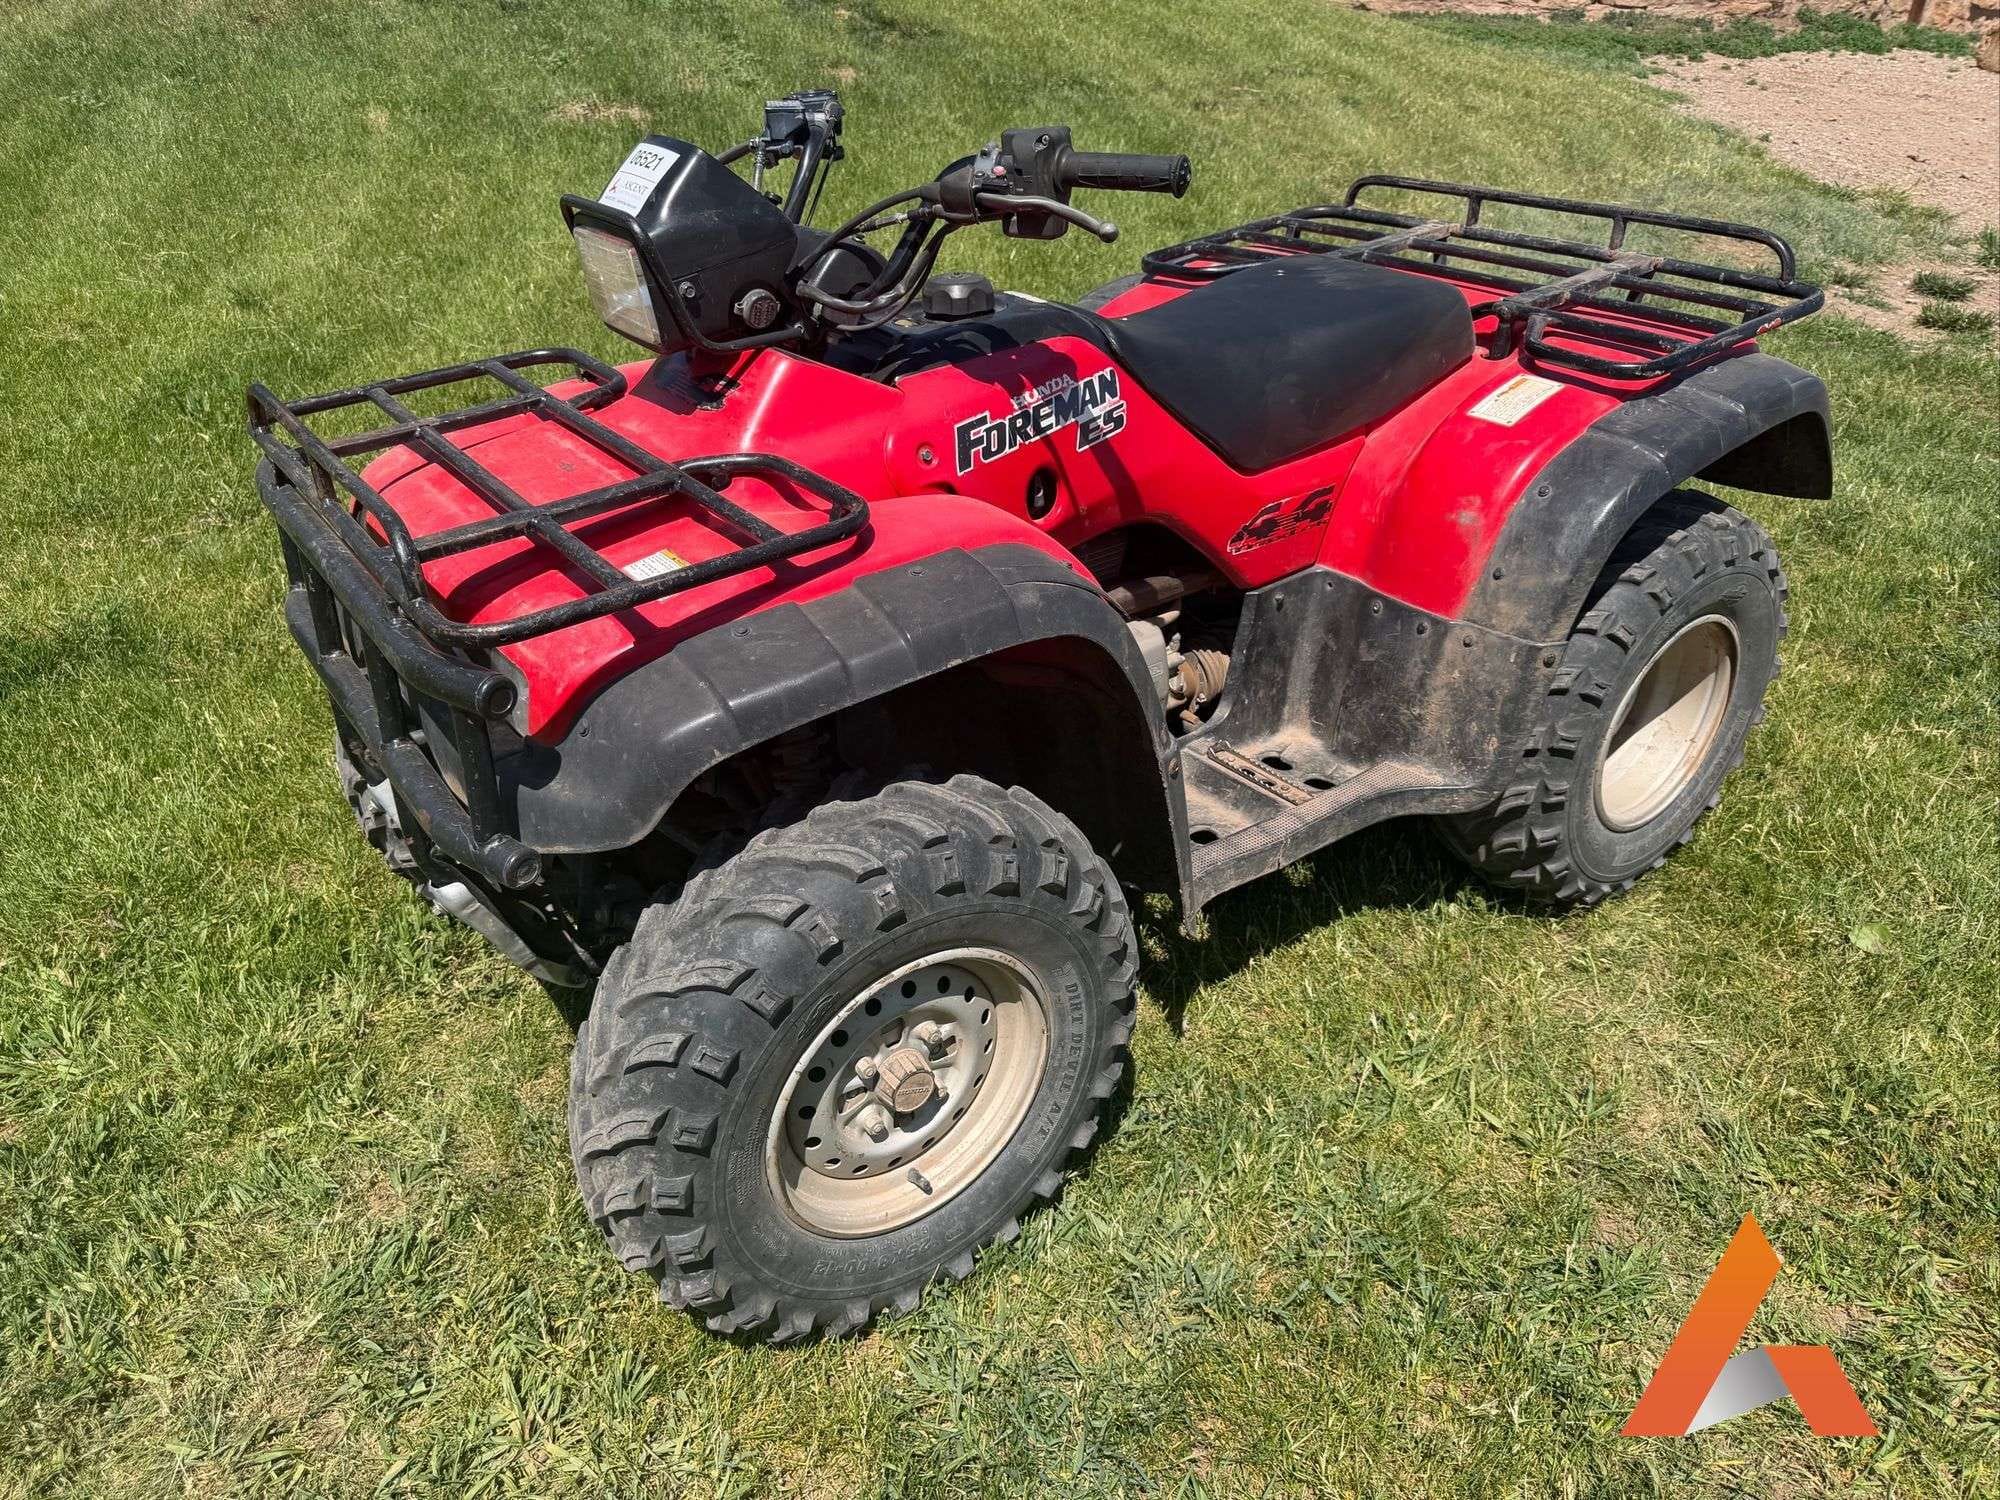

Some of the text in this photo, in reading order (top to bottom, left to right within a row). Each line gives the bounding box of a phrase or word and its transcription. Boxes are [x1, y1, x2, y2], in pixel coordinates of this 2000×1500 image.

[1011, 374, 1079, 410] HONDA
[954, 367, 1120, 476] FOREMAN
[1076, 401, 1126, 452] ES
[1064, 982, 1084, 1025] DIRT
[1058, 1032, 1085, 1094] DEVIL
[897, 1087, 931, 1097] HONDA
